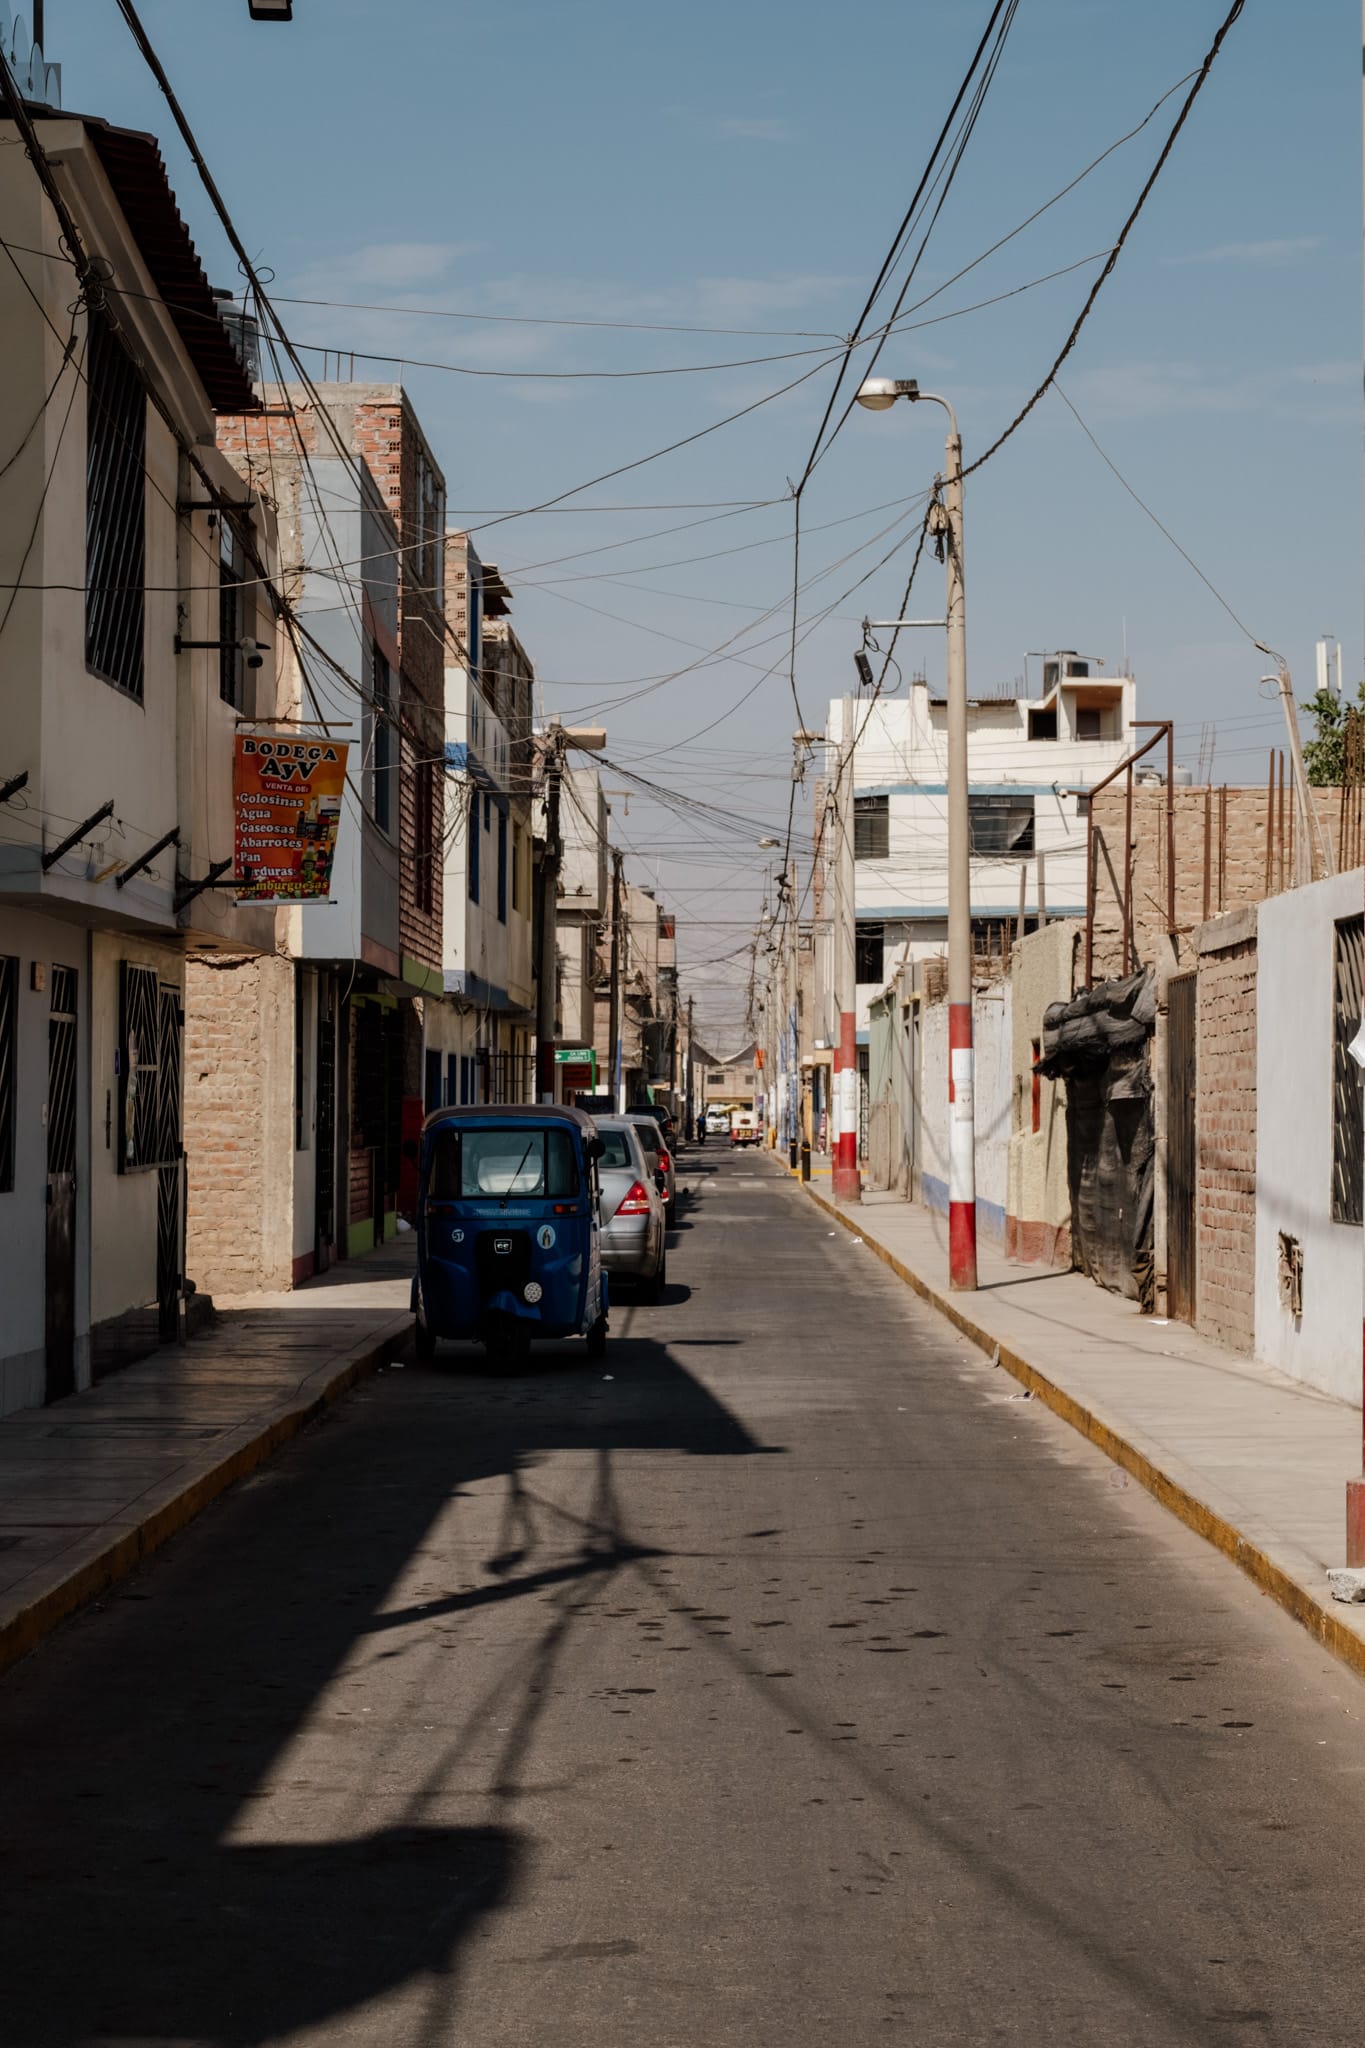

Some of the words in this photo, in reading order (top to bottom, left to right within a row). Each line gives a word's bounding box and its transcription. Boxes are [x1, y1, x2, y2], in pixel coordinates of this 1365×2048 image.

[243, 739, 337, 761] BODEGA
[260, 757, 317, 779] AyV
[265, 782, 293, 792] VENTA
[240, 793, 304, 807] Golosinas
[240, 808, 271, 820] Agua
[240, 823, 296, 834] Gaseosas
[240, 837, 302, 848] Abarrotes
[240, 852, 261, 862] Pan
[240, 866, 294, 876] Vrduras
[240, 881, 328, 892] amburguesas
